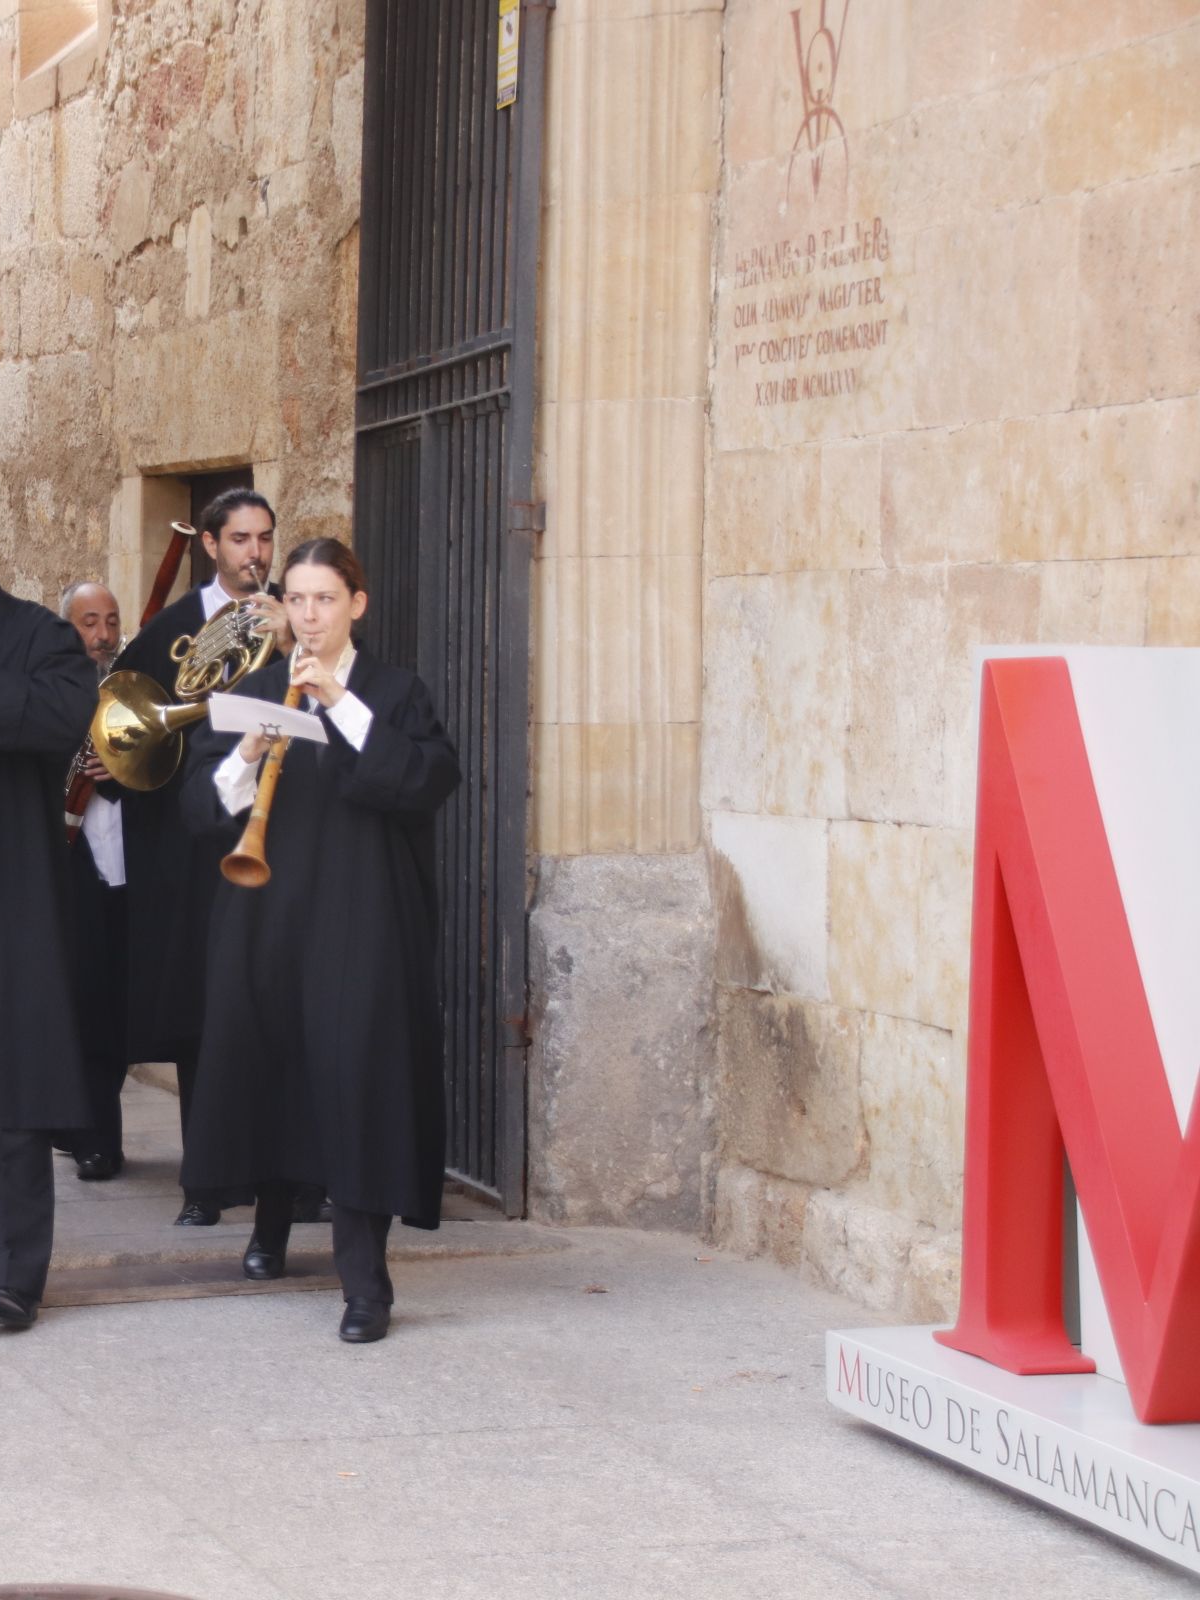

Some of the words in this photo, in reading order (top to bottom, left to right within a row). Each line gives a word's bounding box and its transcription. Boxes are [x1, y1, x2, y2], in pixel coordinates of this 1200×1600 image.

[837, 1342, 933, 1430] MUSEO
[946, 1396, 982, 1455] DE
[996, 1409, 1200, 1554] SALAMANCA
